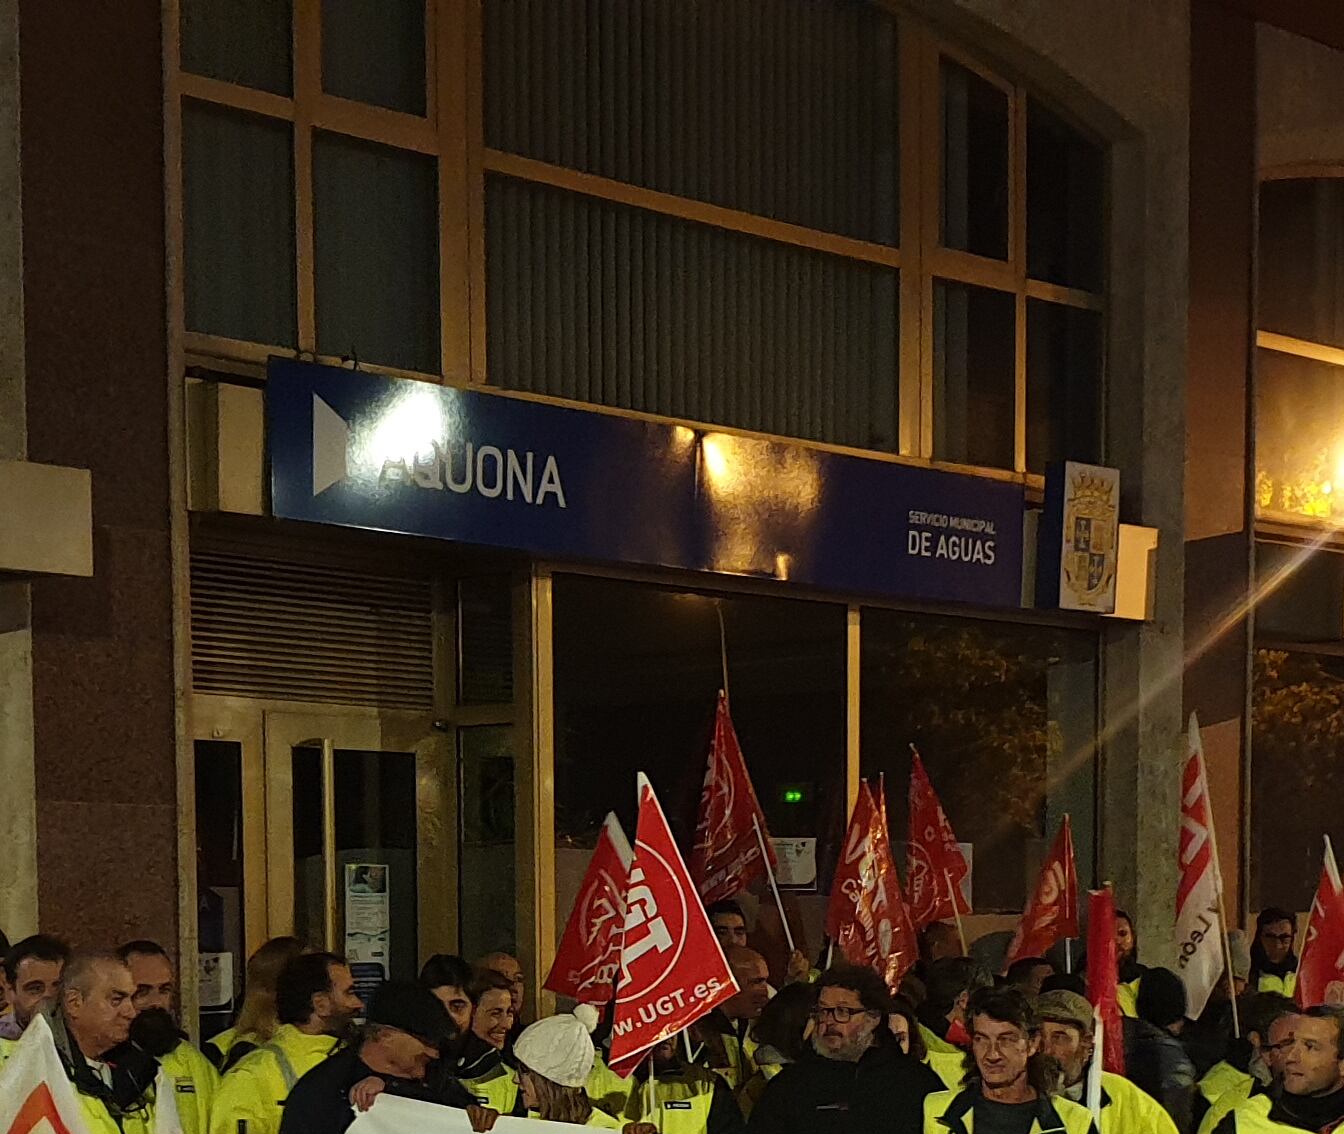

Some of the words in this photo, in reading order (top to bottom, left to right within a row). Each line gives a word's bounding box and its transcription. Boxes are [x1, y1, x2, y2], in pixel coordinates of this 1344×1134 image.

[378, 432, 567, 508] AQUONA
[908, 510, 949, 528] SERVICIO
[949, 516, 996, 535] MUNICIPAL
[908, 530, 932, 557] DE
[936, 534, 995, 565] AGUAS
[612, 976, 722, 1039] w.UGT.es
